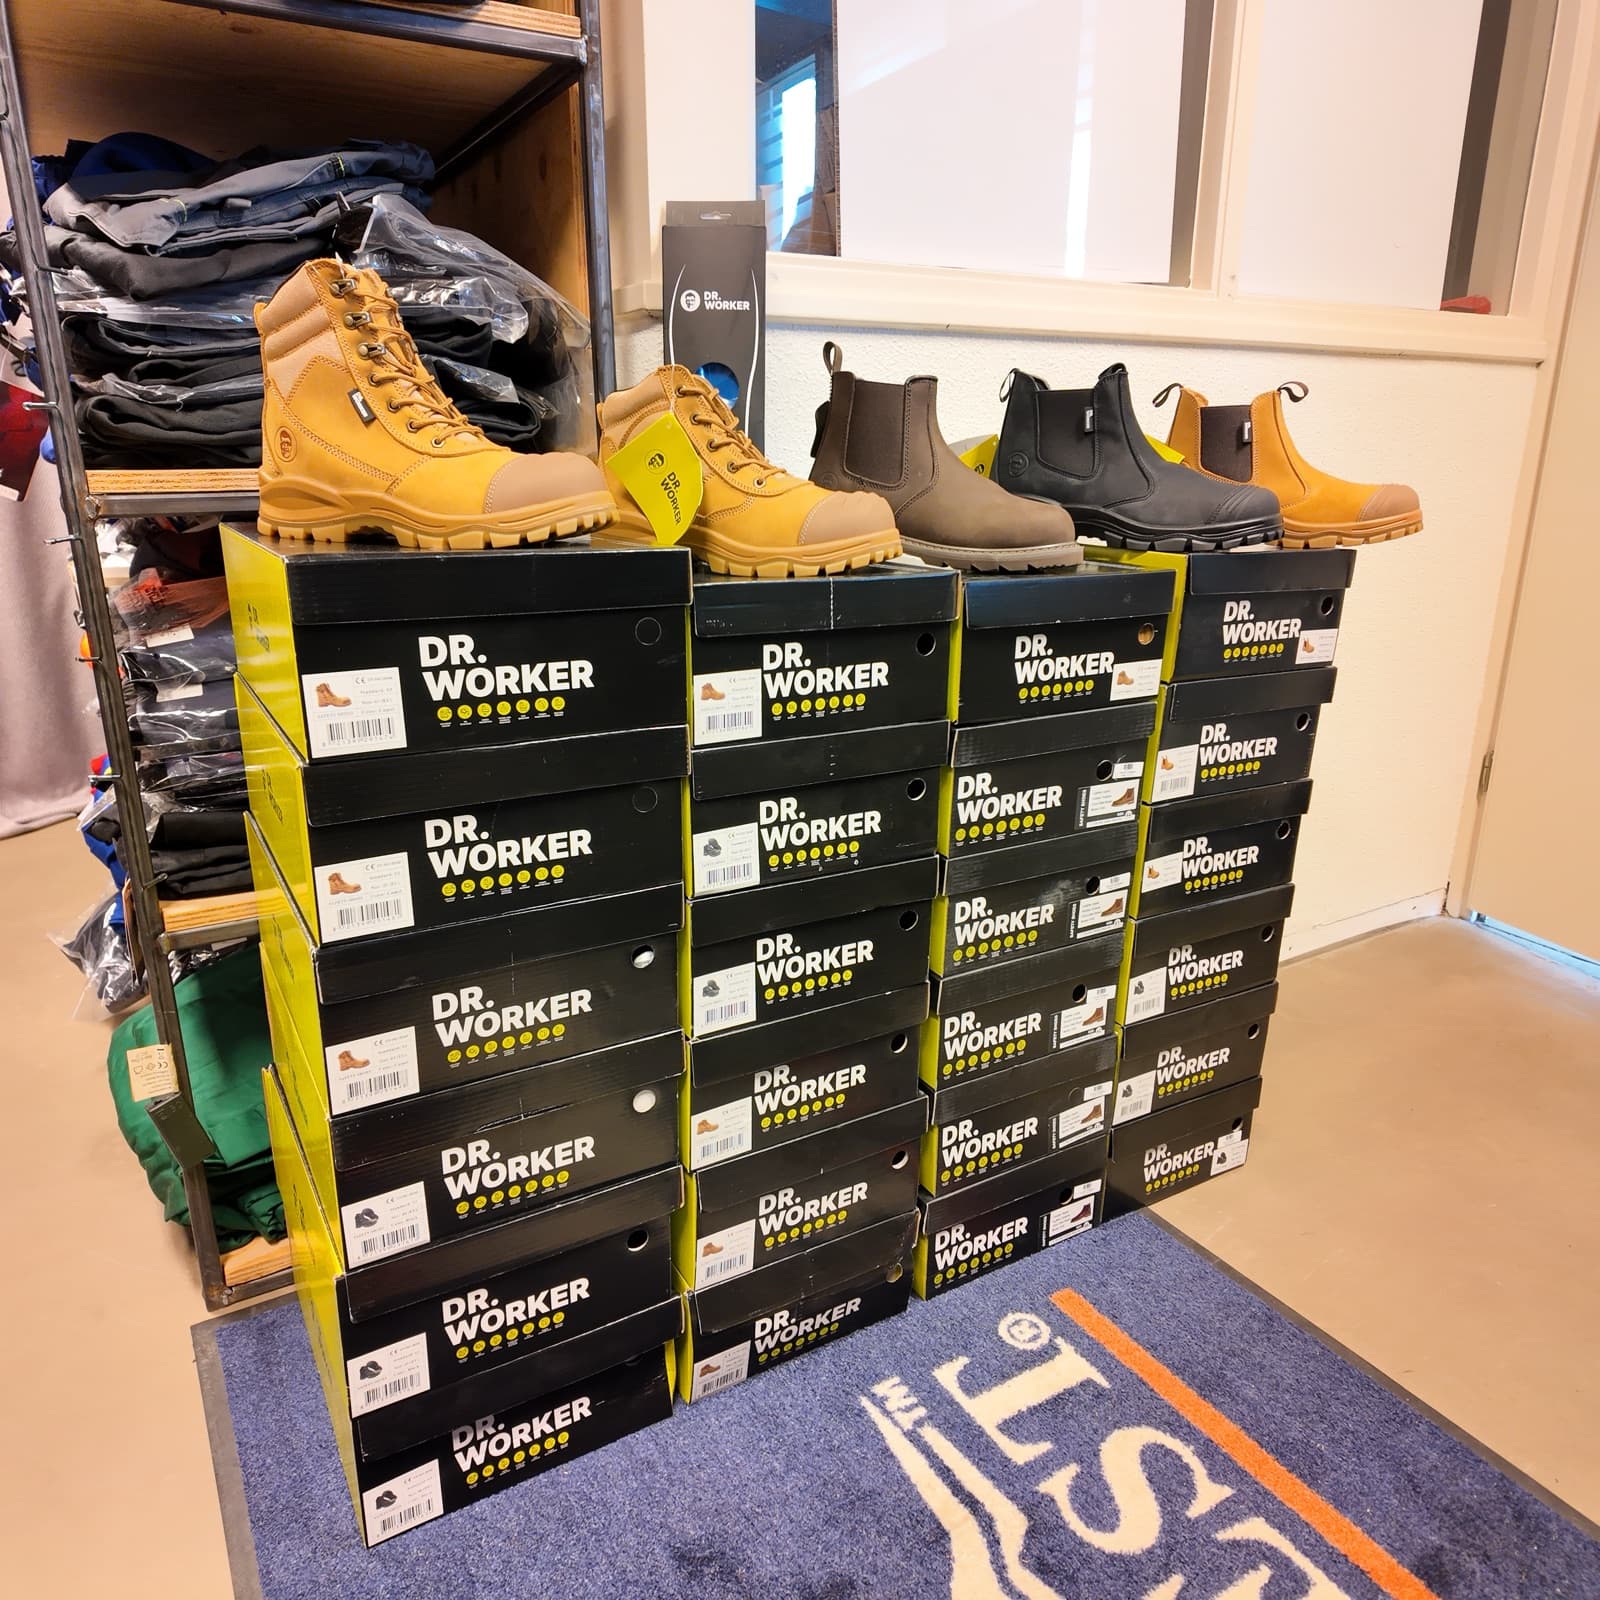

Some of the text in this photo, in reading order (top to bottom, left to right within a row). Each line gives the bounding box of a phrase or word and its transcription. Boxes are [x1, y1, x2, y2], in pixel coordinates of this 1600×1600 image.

[704, 291, 721, 300] DR.
[704, 301, 750, 311] WORKER
[667, 471, 680, 493] DR.
[661, 478, 682, 525] WORKER
[1223, 600, 1254, 622] DR.
[1015, 634, 1053, 658] DR.
[1223, 618, 1301, 645] WORKER
[418, 634, 487, 667] DR.
[763, 642, 811, 669] DR.
[422, 660, 595, 701] WORKER
[764, 662, 888, 699] WORKER
[1015, 651, 1114, 684] WORKER
[1201, 723, 1230, 744] DR.
[1200, 737, 1277, 766] WORKER
[957, 772, 998, 799] DR.
[759, 797, 806, 825] DR.
[957, 785, 1062, 824] WORKER
[424, 815, 489, 848] DR.
[760, 811, 881, 851] WORKER
[1183, 837, 1211, 858] DR.
[427, 830, 592, 878] WORKER
[1183, 846, 1259, 878] WORKER
[955, 897, 992, 923] DR.
[955, 904, 1054, 946] WORKER
[756, 933, 800, 961] DR.
[757, 940, 874, 986] WORKER
[1168, 944, 1196, 967] DR.
[1168, 950, 1244, 986] WORKER
[432, 986, 494, 1021] DR.
[435, 989, 592, 1048] WORKER
[944, 1011, 981, 1039] DR.
[944, 1012, 1042, 1060] WORKER
[1156, 1048, 1230, 1086] WORKER
[1157, 1046, 1185, 1068] DR.
[754, 1064, 797, 1093] DR.
[754, 1064, 866, 1115] WORKER
[942, 1119, 979, 1148] DR.
[942, 1117, 1038, 1168] WORKER
[442, 1139, 500, 1175] DR.
[444, 1136, 595, 1201] WORKER
[1144, 1143, 1171, 1166] DR.
[1144, 1141, 1215, 1183] WORKER
[759, 1187, 801, 1215] DR.
[759, 1182, 868, 1236] WORKER
[935, 1223, 970, 1251] DR.
[935, 1217, 1029, 1270] WORKER
[442, 1288, 497, 1323] DR.
[444, 1278, 589, 1346] WORKER
[755, 1309, 796, 1339] DR.
[755, 1297, 861, 1353] WORKER
[451, 1414, 504, 1447] DR.
[455, 1397, 591, 1473] WORKER
